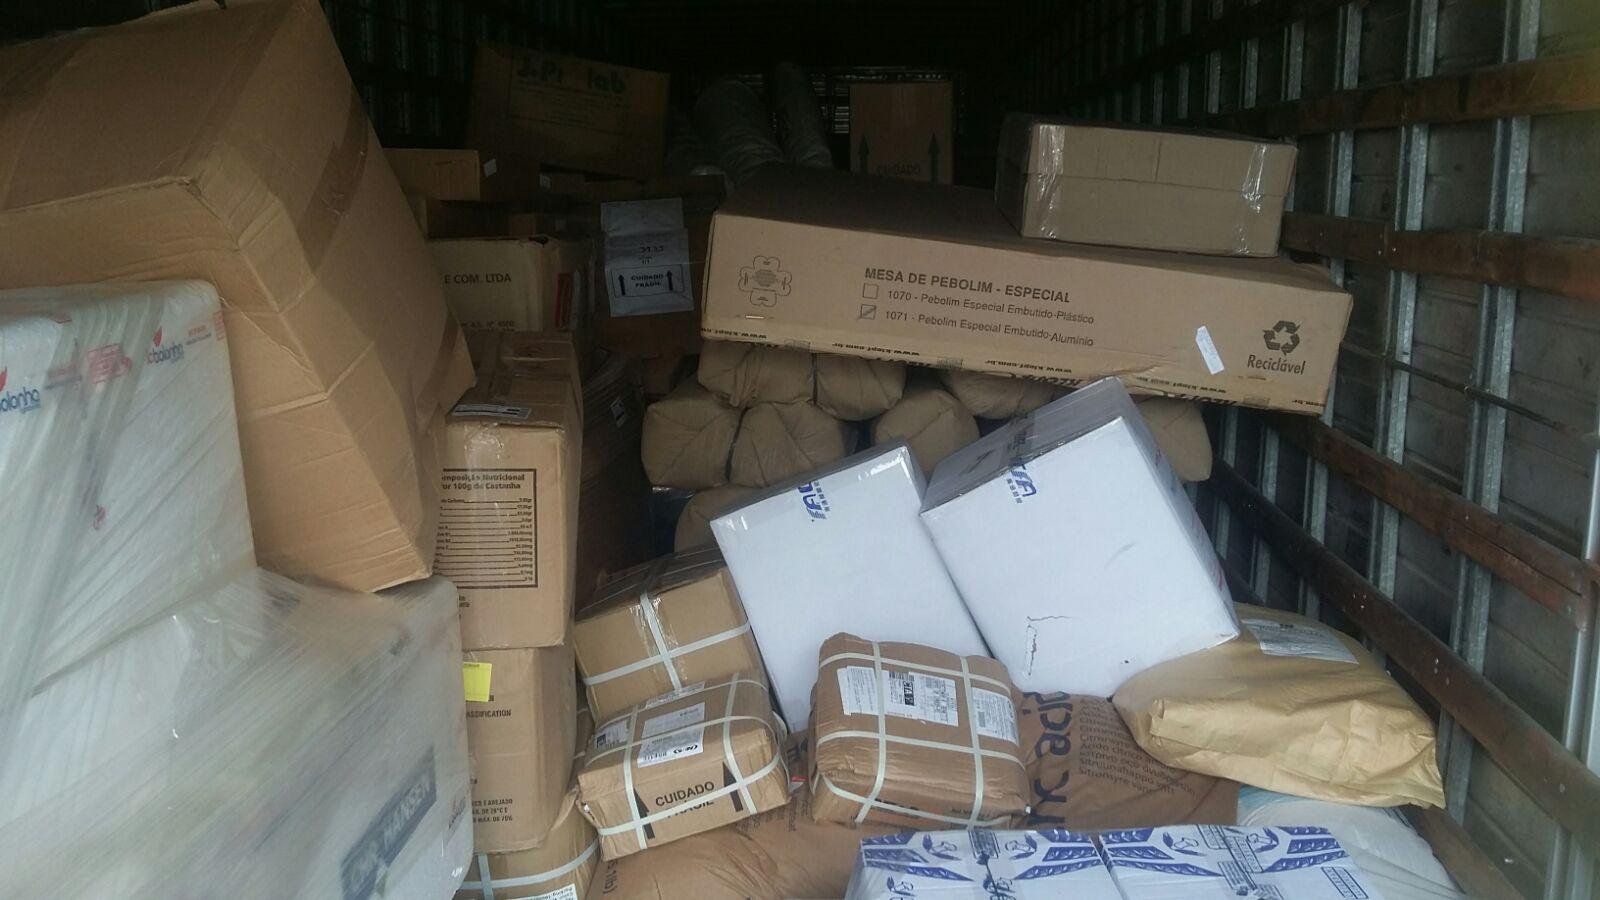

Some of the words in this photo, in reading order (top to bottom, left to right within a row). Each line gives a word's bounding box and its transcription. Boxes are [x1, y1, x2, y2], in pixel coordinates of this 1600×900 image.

[485, 273, 512, 283] LTDA
[864, 267, 904, 282] MESA
[908, 272, 927, 285] DE
[931, 275, 993, 294] PEBOLIM
[1004, 284, 1071, 303] ESPECIAL
[887, 289, 912, 301] 1070
[921, 293, 961, 307] Pebolim
[963, 298, 1005, 313] Especial
[885, 310, 908, 321] 1071
[918, 314, 957, 328] Pebolim
[960, 320, 1001, 334] Especial
[1247, 354, 1306, 375] Reciclável
[453, 483, 472, 491] 100g
[485, 482, 521, 490] Castanha
[655, 781, 715, 807] CUIDADO
